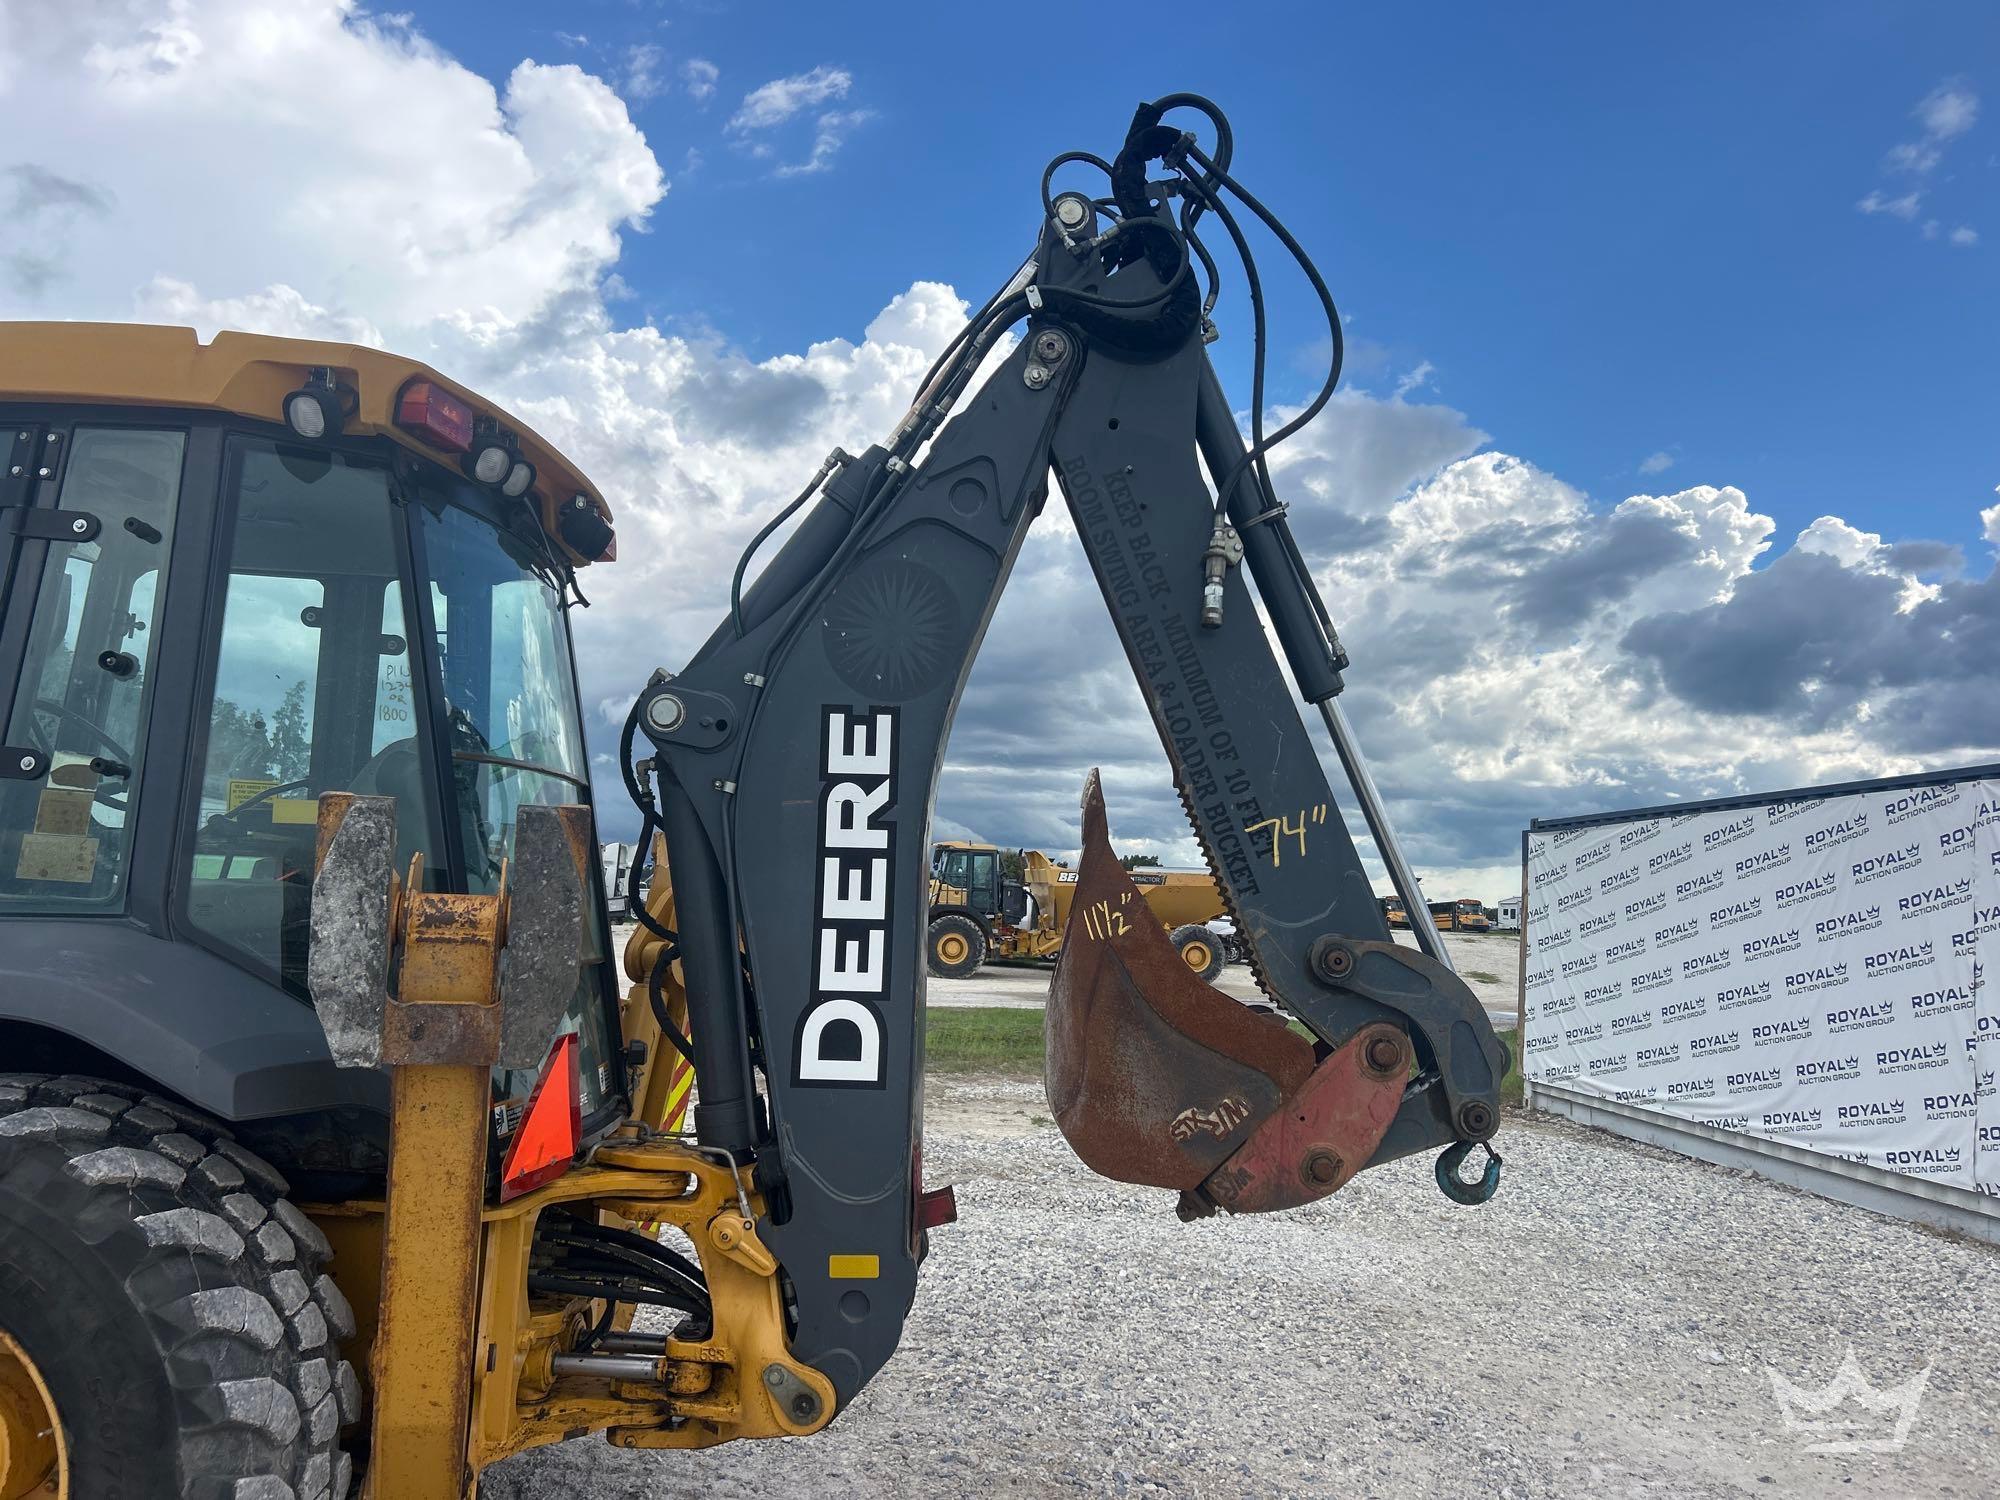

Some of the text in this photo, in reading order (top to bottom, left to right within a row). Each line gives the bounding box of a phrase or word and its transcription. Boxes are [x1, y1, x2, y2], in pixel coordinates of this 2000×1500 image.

[1102, 470, 1143, 529] KEEP
[1128, 532, 1172, 599] BACK
[1064, 455, 1261, 897] BOOM SWING AREA & LOADER BUCKET
[1160, 613, 1224, 728] MINIMUM
[1209, 730, 1240, 760] OF
[1224, 768, 1251, 795] 10
[1885, 788, 1941, 816] ROYAL
[1888, 794, 1958, 824] AUCTION GROUP
[1769, 810, 1799, 826] AUCTION
[1236, 797, 1276, 859] FEET
[1244, 804, 1327, 867] 74"
[1620, 824, 1651, 845] ROYAL
[1704, 822, 1743, 845] ROYAL
[1805, 820, 1854, 847] ROYAL
[1940, 824, 1975, 848] ROY
[1705, 828, 1754, 852] AUCTION GROUP
[1808, 827, 1868, 854] AUCTION GROUP
[1942, 841, 1975, 857] AUCTIO
[1575, 847, 1603, 866] ROYAL
[1649, 847, 1682, 868] ROYAL
[1736, 849, 1778, 872] ROYAL
[1852, 850, 1906, 876] ROYAL
[1737, 856, 1790, 880] AUCTION GROUP
[1855, 858, 1922, 884] AUCTION GROUP
[1600, 870, 1630, 889] ROYAL
[1676, 874, 1712, 895] ROYAL
[1676, 874, 1712, 895] ROYAL
[799, 713, 893, 1082] DEERE
[1558, 890, 1584, 907] ROYAL
[1677, 881, 1723, 902] AUCTION GROUP
[1775, 878, 1822, 901] ROYAL
[1777, 886, 1836, 909] AUCTION GROUP
[1899, 885, 1955, 911] ROYAL
[1626, 896, 1657, 915] ROYAL
[1710, 902, 1749, 922] ROYAL
[1901, 894, 1972, 919] AUCTION GROUP
[1580, 915, 1608, 932] ROYAL
[1711, 910, 1761, 929] AUCTION GROUP
[1815, 911, 1866, 934] ROYAL
[1655, 923, 1688, 941] ROYAL
[1818, 920, 1881, 942] AUCTION GROUP
[1606, 941, 1636, 958] ROYAL
[1743, 934, 1787, 954] ROYAL
[1745, 942, 1800, 961] AUCTION GROUP
[1562, 957, 1589, 972] ROYAL
[1683, 953, 1719, 971] ROYAL
[1865, 946, 1919, 969] ROYAL
[1868, 956, 1935, 977] AUCTION GROUP
[1631, 970, 1663, 987] ROYAL
[1684, 961, 1730, 978] AUCTION GROUP
[1785, 967, 1834, 987] ROYAL
[1584, 985, 1613, 1000] ROYAL
[1717, 985, 1758, 1003] ROYAL
[1788, 977, 1848, 995] AUCTION GROUP
[1719, 994, 1771, 1010] AUCTION GROUP
[1912, 986, 1968, 1008] ROYAL
[1661, 1000, 1696, 1017] ROYAL
[1827, 1005, 1879, 1024] ROYAL
[1914, 998, 1975, 1018] AUCTION GRO
[1611, 1014, 1642, 1029] ROYAL
[1752, 1021, 1798, 1038] ROYAL
[1829, 1016, 1894, 1033] AUCTION GROUP
[1566, 1025, 1594, 1039] ROYAL
[1754, 1031, 1811, 1046] AUCTION GROUP
[1690, 1034, 1728, 1050] ROYAL
[1692, 1044, 1739, 1057] AUCTION GROUP
[1589, 1056, 1618, 1069] ROYAL
[1637, 1046, 1670, 1061] ROYAL
[1877, 1046, 1932, 1065] ROYAL
[1796, 1059, 1845, 1076] ROYAL
[1879, 1059, 1948, 1074] AUCTION GROUP
[1668, 1080, 1704, 1094] ROYAL
[1727, 1071, 1769, 1086] ROYAL
[1798, 1071, 1860, 1084] AUCTION GROUP
[1729, 1082, 1781, 1093] AUCTION GROUP
[1838, 1103, 1890, 1118] ROYAL
[1924, 1092, 1976, 1111] ROYA
[1763, 1111, 1808, 1125] ROYAL
[1840, 1116, 1905, 1127] AUCTION GROUP
[1927, 1110, 1966, 1120] AUCTION
[1886, 1149, 1944, 1164] ROYAL
